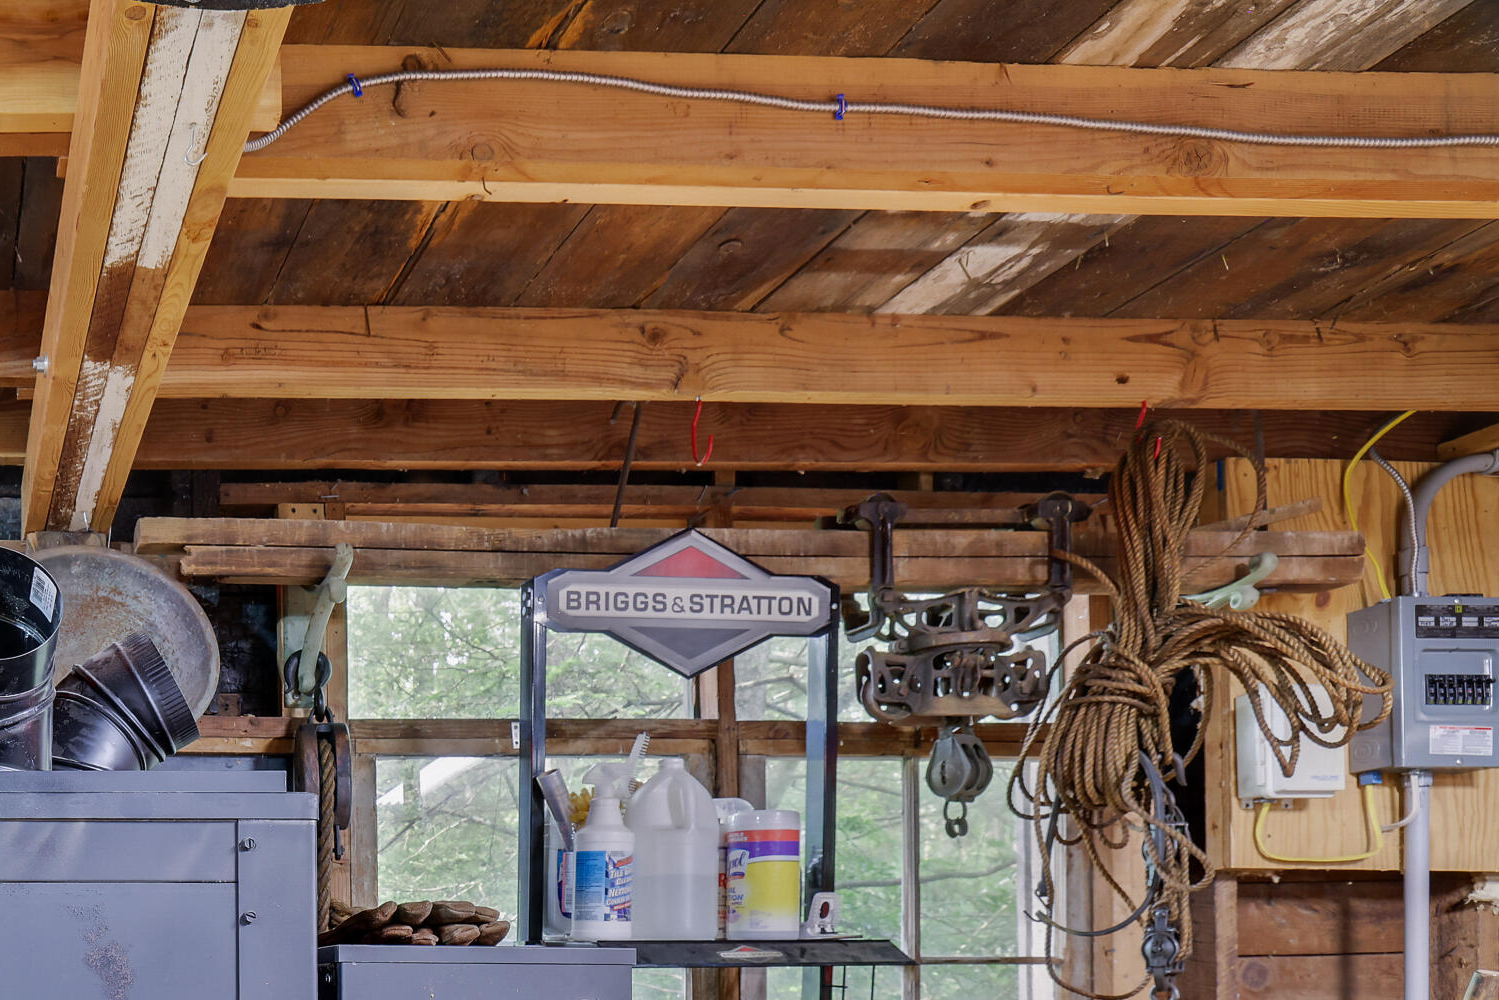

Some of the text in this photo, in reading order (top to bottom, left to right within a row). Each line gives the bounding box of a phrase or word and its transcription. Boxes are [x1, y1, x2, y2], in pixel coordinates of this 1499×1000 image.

[565, 590, 812, 617] BRIGGS & STRATTON
